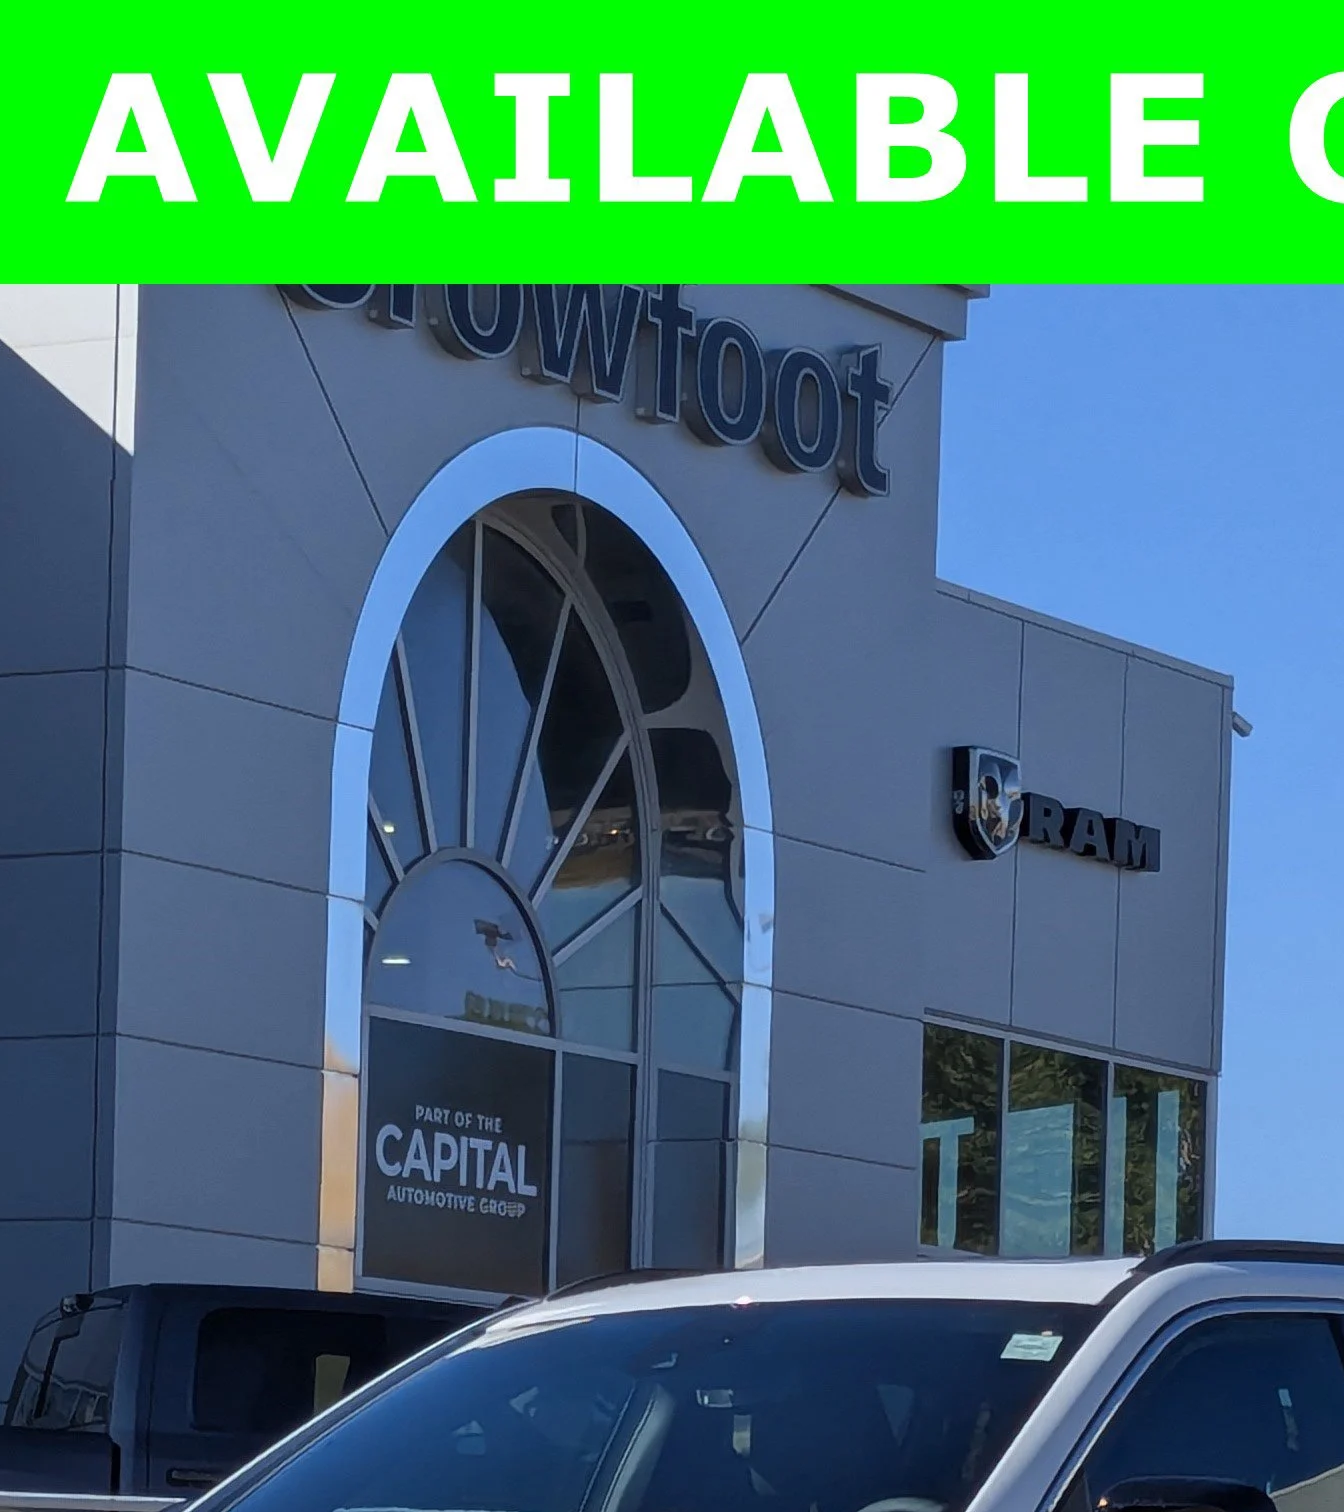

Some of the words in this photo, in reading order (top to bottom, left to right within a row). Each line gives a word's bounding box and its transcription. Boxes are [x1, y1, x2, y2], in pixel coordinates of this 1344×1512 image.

[291, 284, 895, 498] owfoot
[1028, 791, 1161, 873] RAM
[414, 1104, 451, 1124] PART
[454, 1111, 473, 1129] OF
[477, 1115, 503, 1134] THE
[375, 1123, 538, 1198] CAPITAL
[386, 1184, 475, 1213] AUTOMOTIVE
[479, 1196, 526, 1219] GROUP
